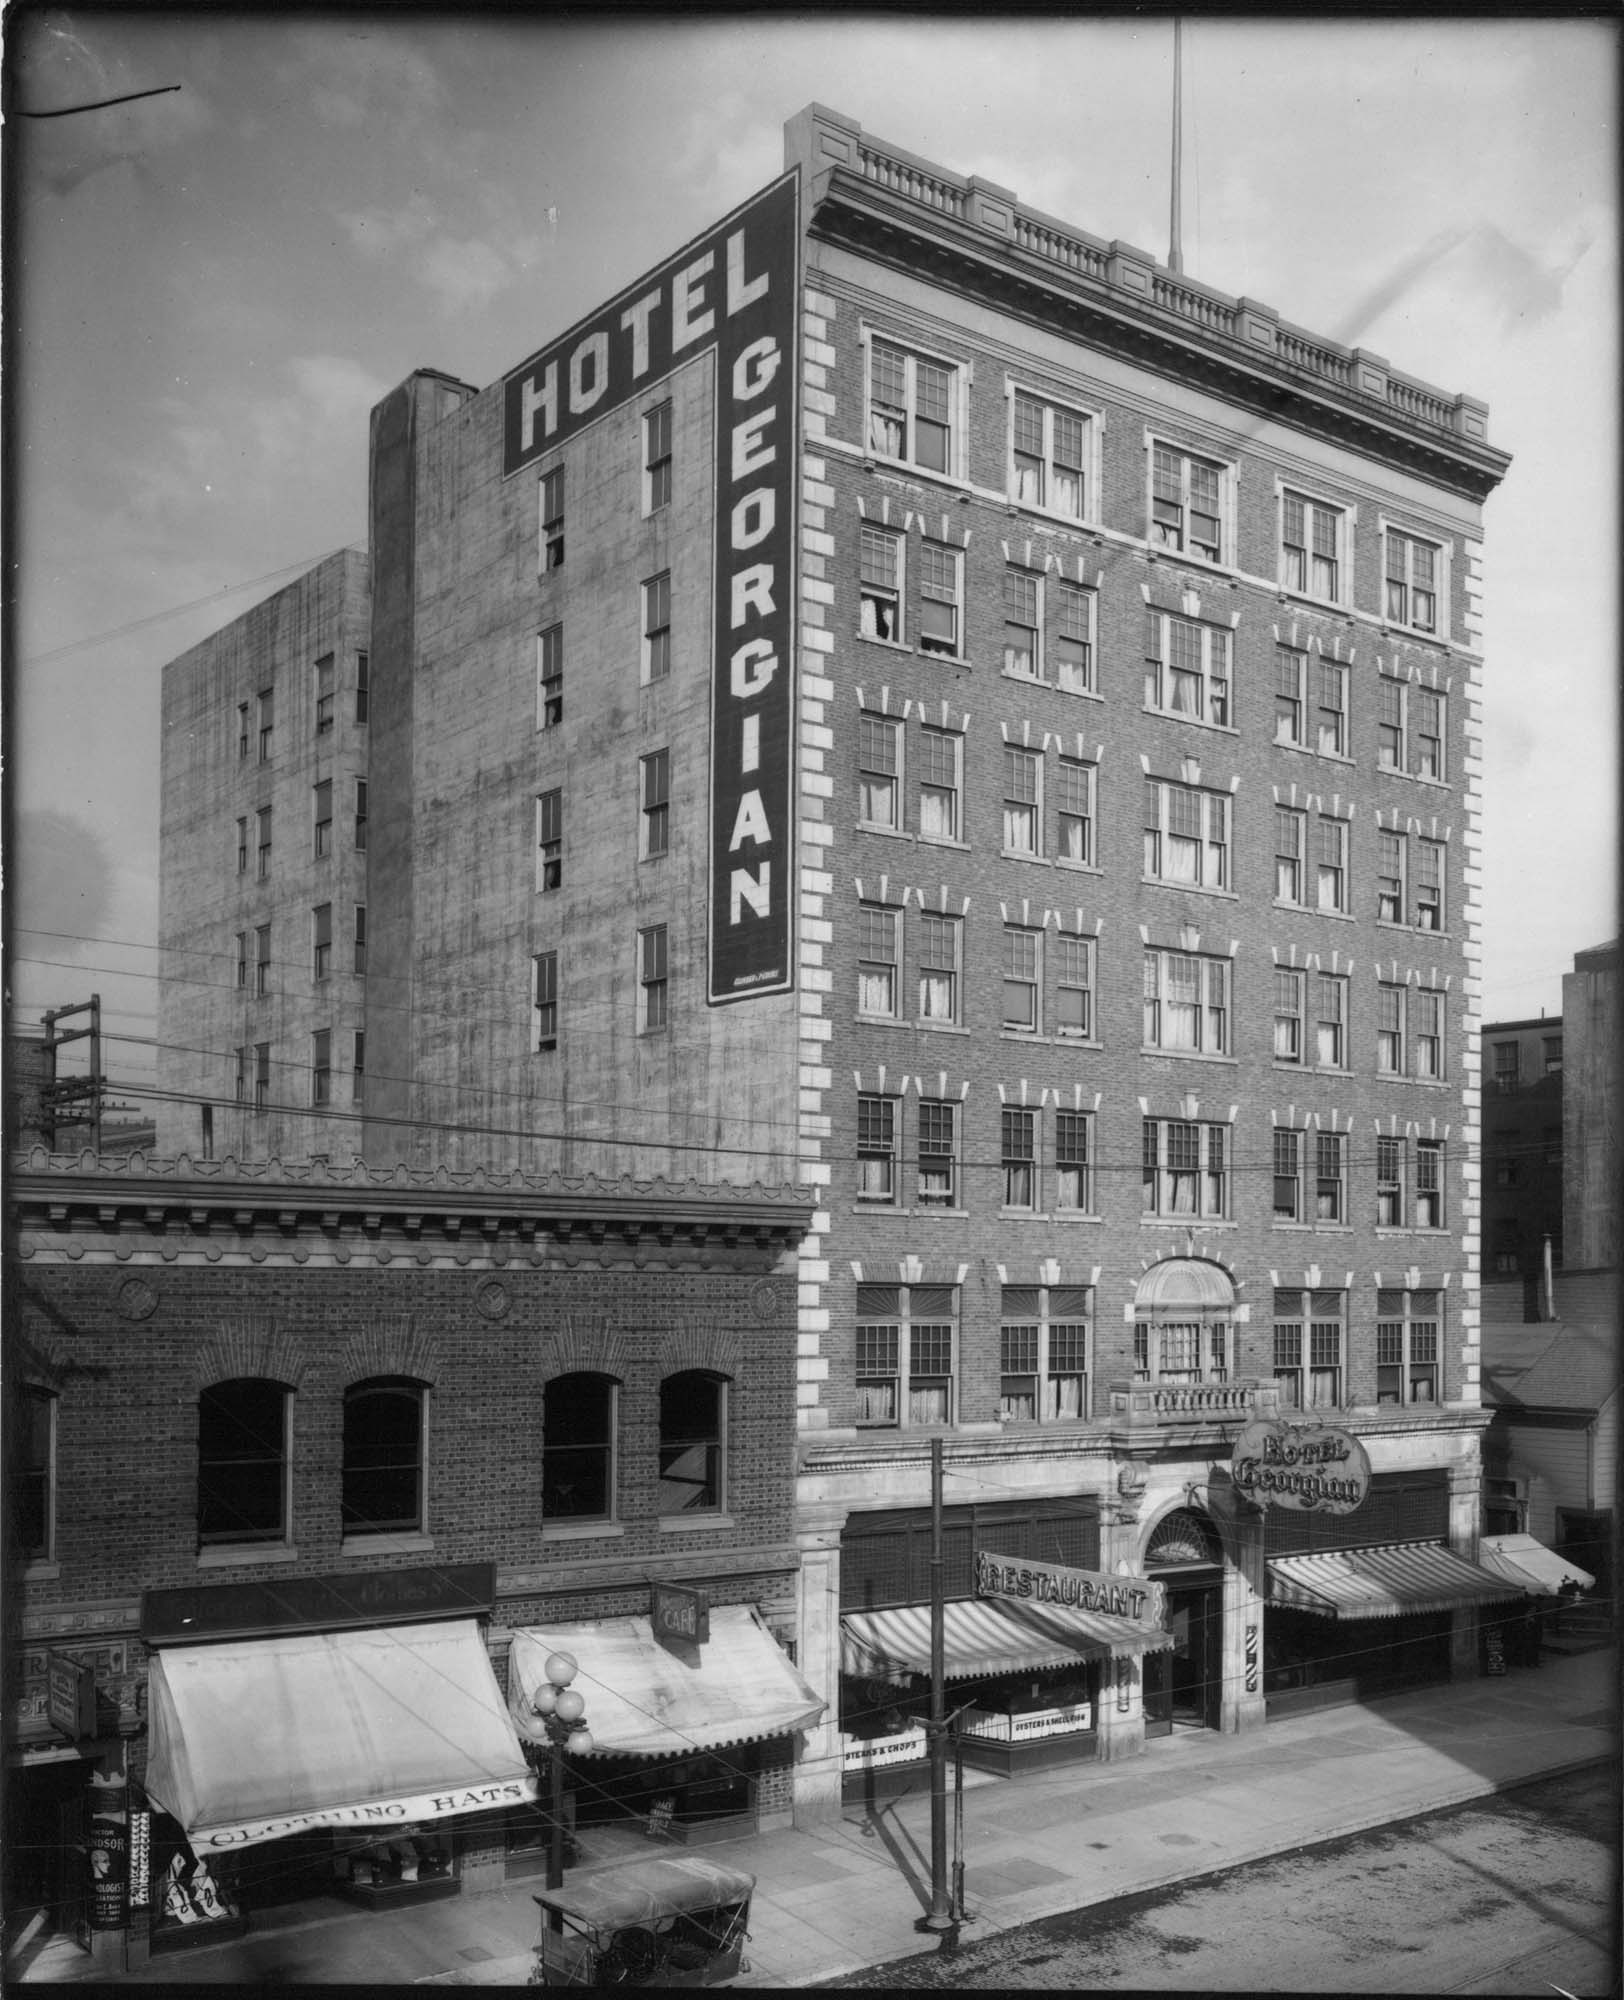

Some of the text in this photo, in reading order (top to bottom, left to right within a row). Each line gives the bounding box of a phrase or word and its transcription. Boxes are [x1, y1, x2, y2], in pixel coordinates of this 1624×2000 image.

[521, 227, 769, 452] HOTEL
[728, 335, 781, 926] GEORGIAN
[1232, 1457, 1361, 1507] Georgian
[985, 1563, 1149, 1620] RESTAURANT
[845, 1748, 877, 1761] STEAKS
[887, 1741, 917, 1754] CHOPS
[208, 1784, 523, 1849] CLOTHING HATS
